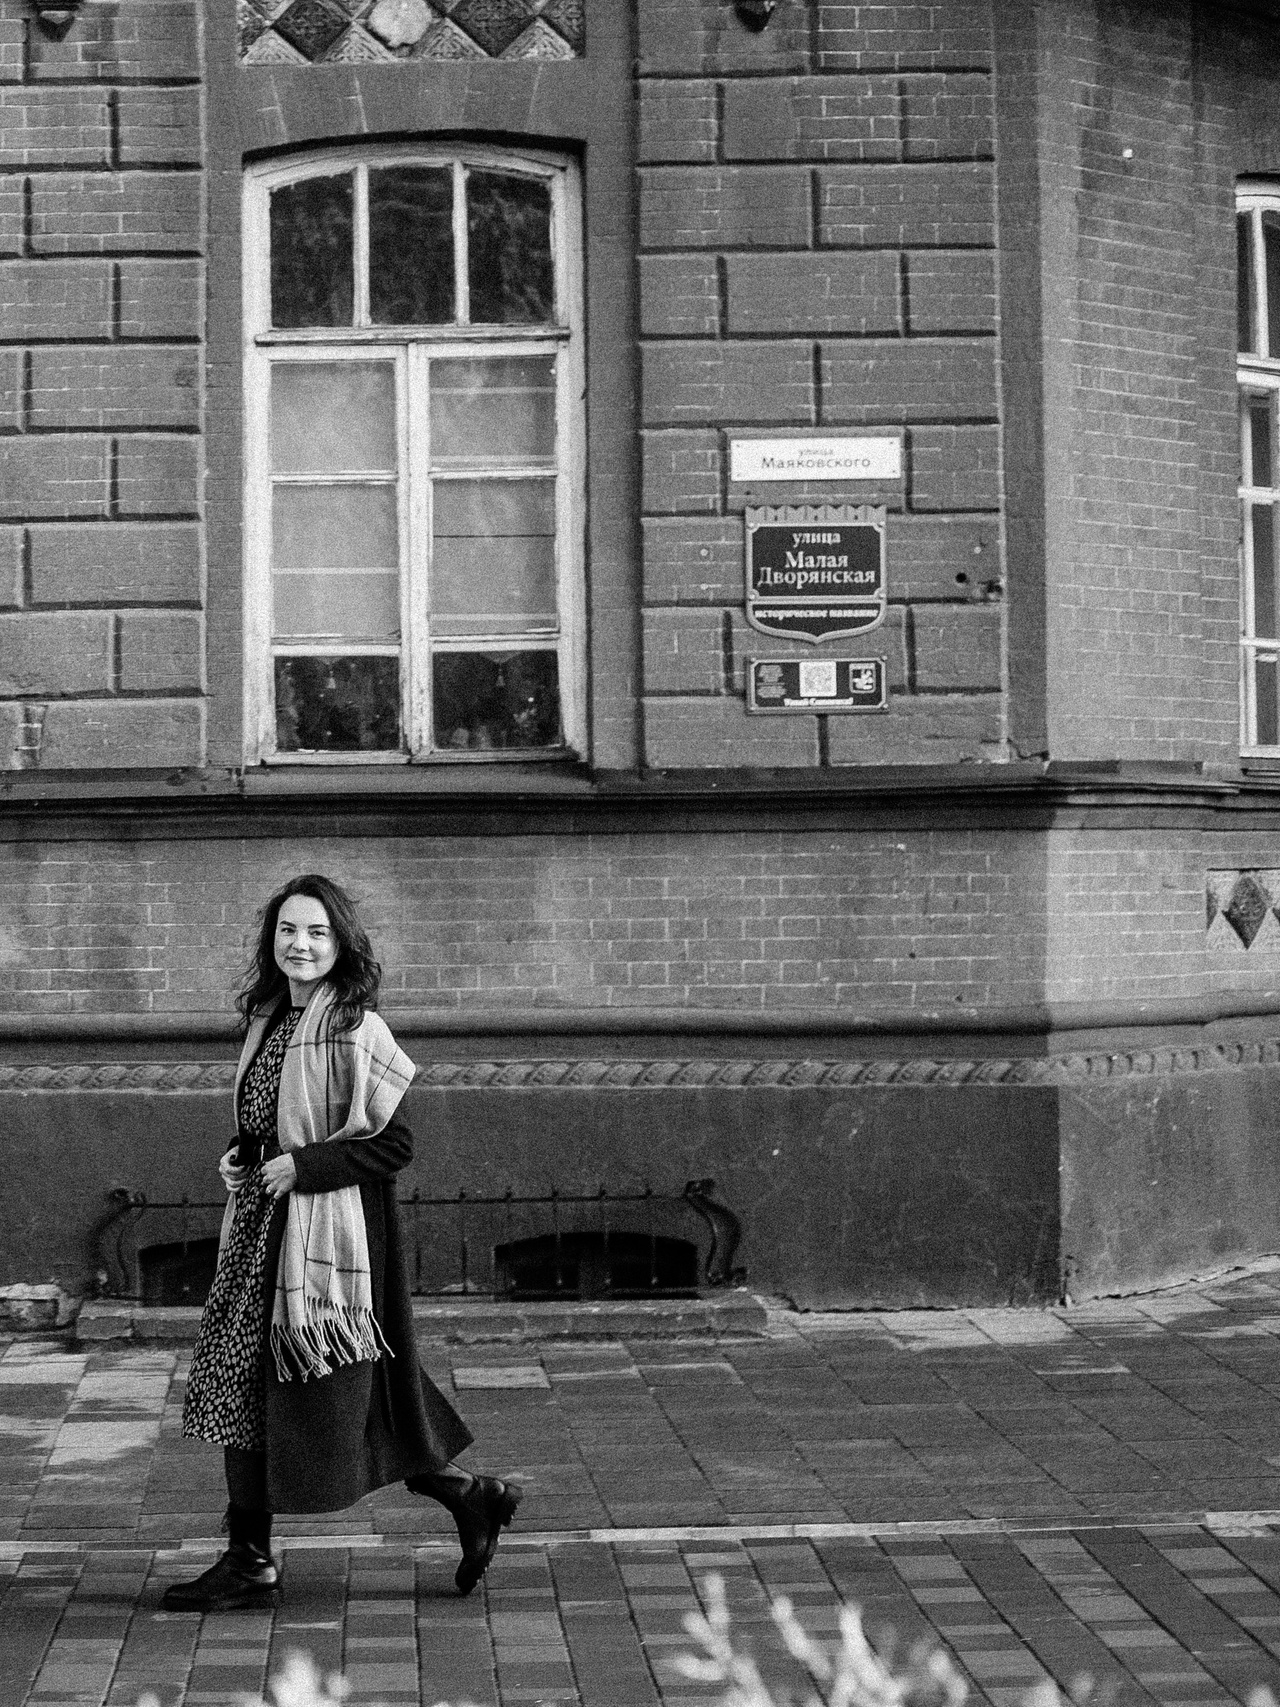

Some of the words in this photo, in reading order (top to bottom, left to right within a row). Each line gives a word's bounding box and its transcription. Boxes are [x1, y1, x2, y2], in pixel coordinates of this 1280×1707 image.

[761, 457, 871, 469] Маяковского
[792, 532, 841, 548] улица
[785, 551, 848, 568] Малая
[757, 566, 876, 589] Дворянская
